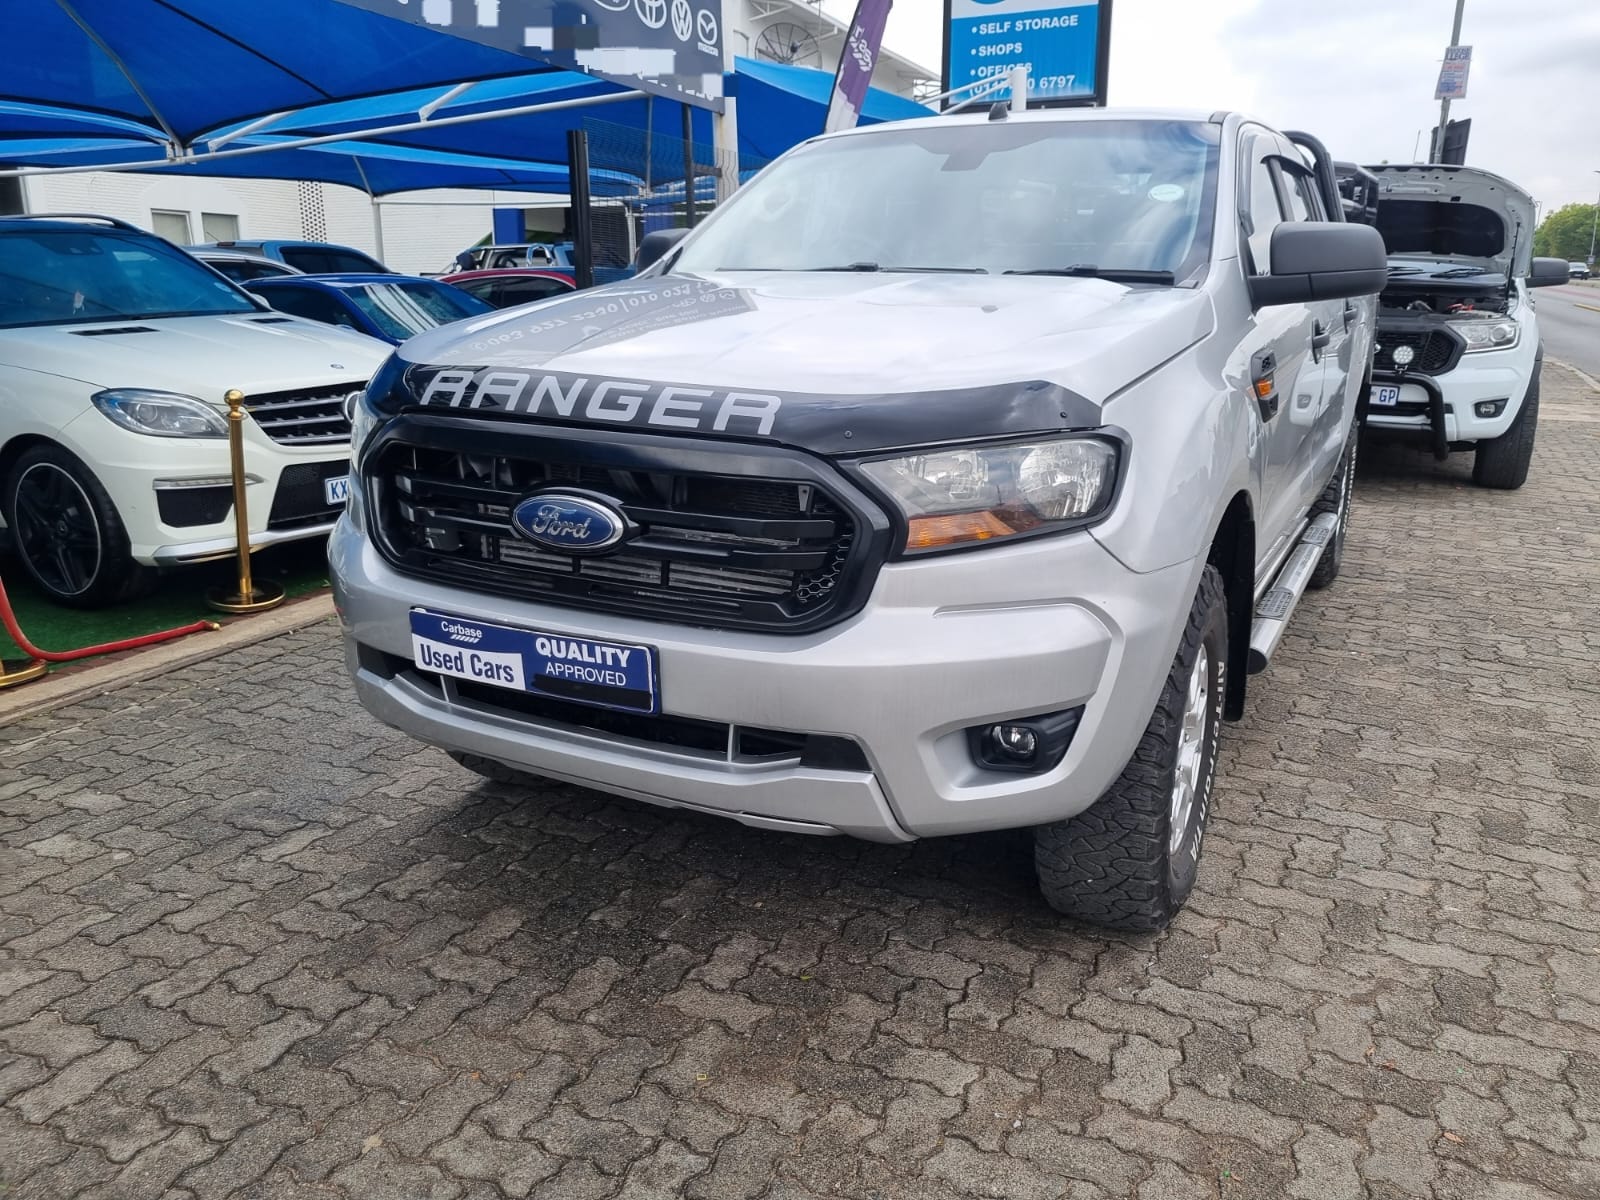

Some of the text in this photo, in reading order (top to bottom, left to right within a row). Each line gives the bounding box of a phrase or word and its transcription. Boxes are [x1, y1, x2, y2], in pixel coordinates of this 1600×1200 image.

[979, 15, 1079, 35] SELF STORAGE
[978, 42, 1023, 57] SHOPS
[1039, 75, 1075, 89] 6797
[419, 370, 782, 435] RANGER
[1379, 388, 1396, 403] GP
[532, 504, 592, 539] Ford
[440, 620, 483, 639] Carbase
[420, 643, 515, 683] Used Cars
[535, 637, 631, 668] QUALITY
[545, 661, 626, 687] APPROVED
